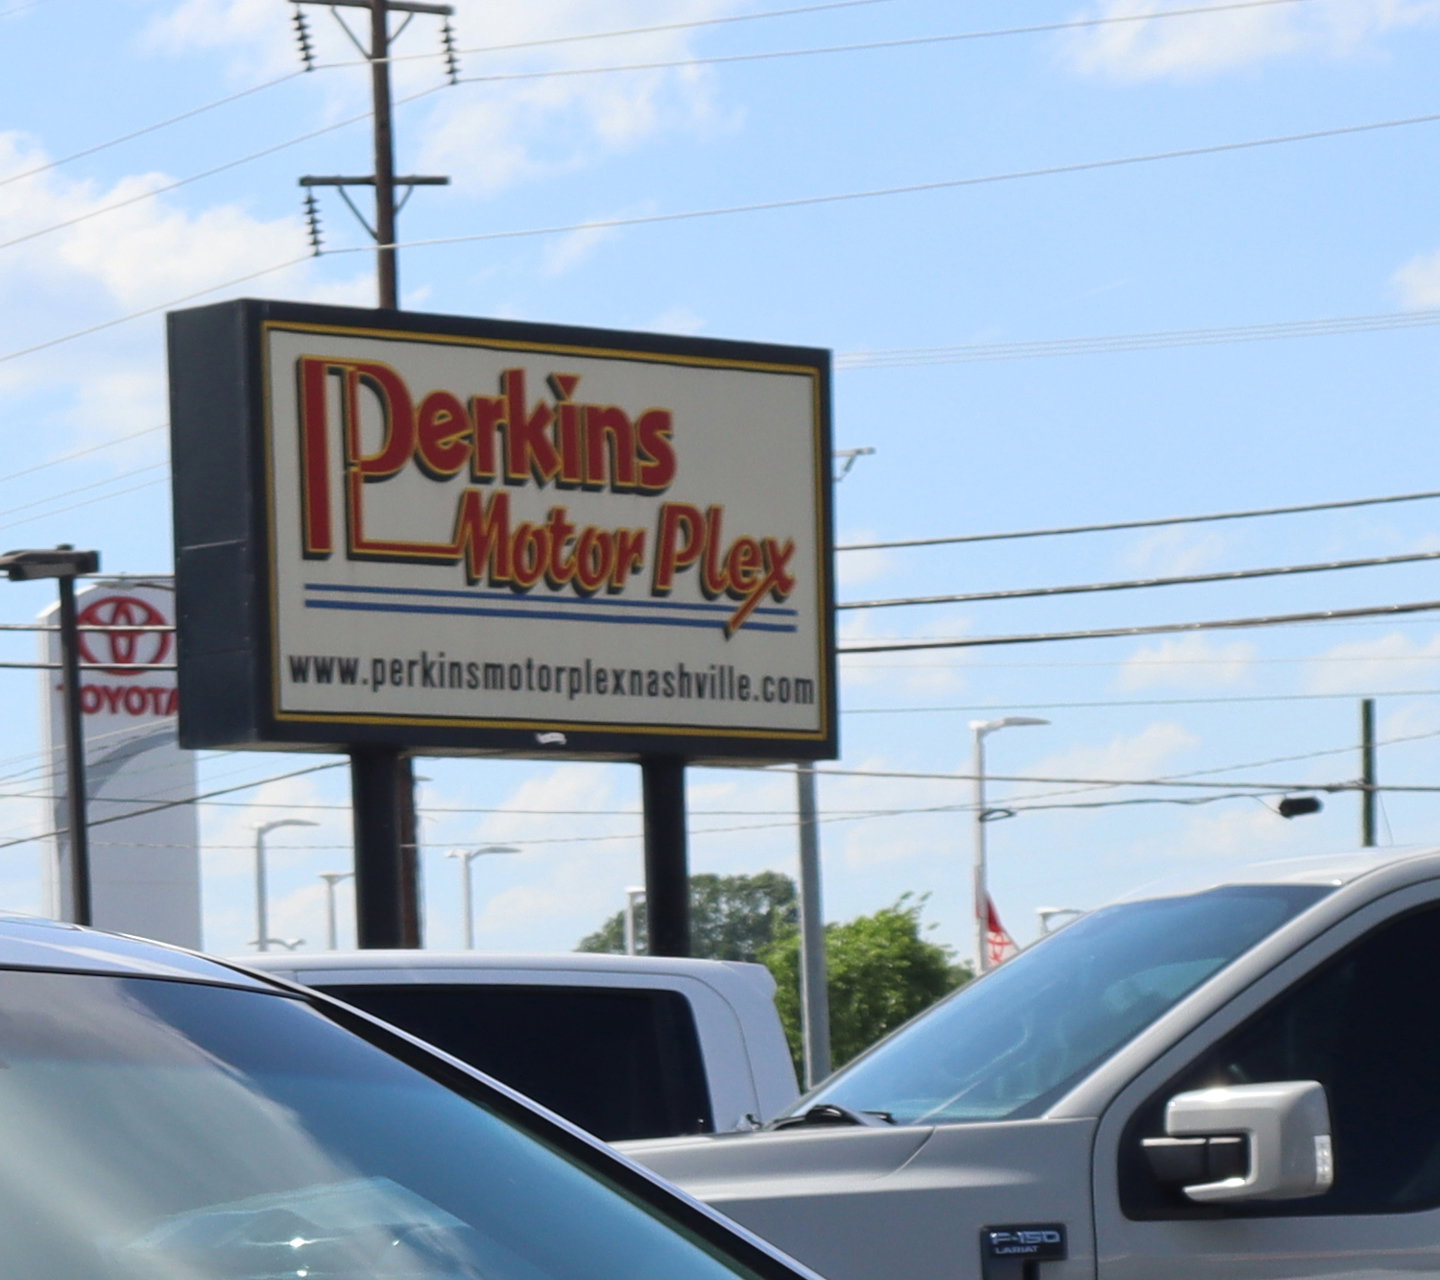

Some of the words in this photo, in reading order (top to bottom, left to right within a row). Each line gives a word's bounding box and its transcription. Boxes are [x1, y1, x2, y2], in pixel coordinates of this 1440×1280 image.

[297, 354, 678, 557] Perkins
[453, 488, 646, 594] Motor
[650, 502, 797, 638] Plex
[56, 684, 179, 716] OYOTA
[288, 650, 816, 705] www.perkinsmotorplexnashville.com
[990, 1230, 1061, 1245] F-150
